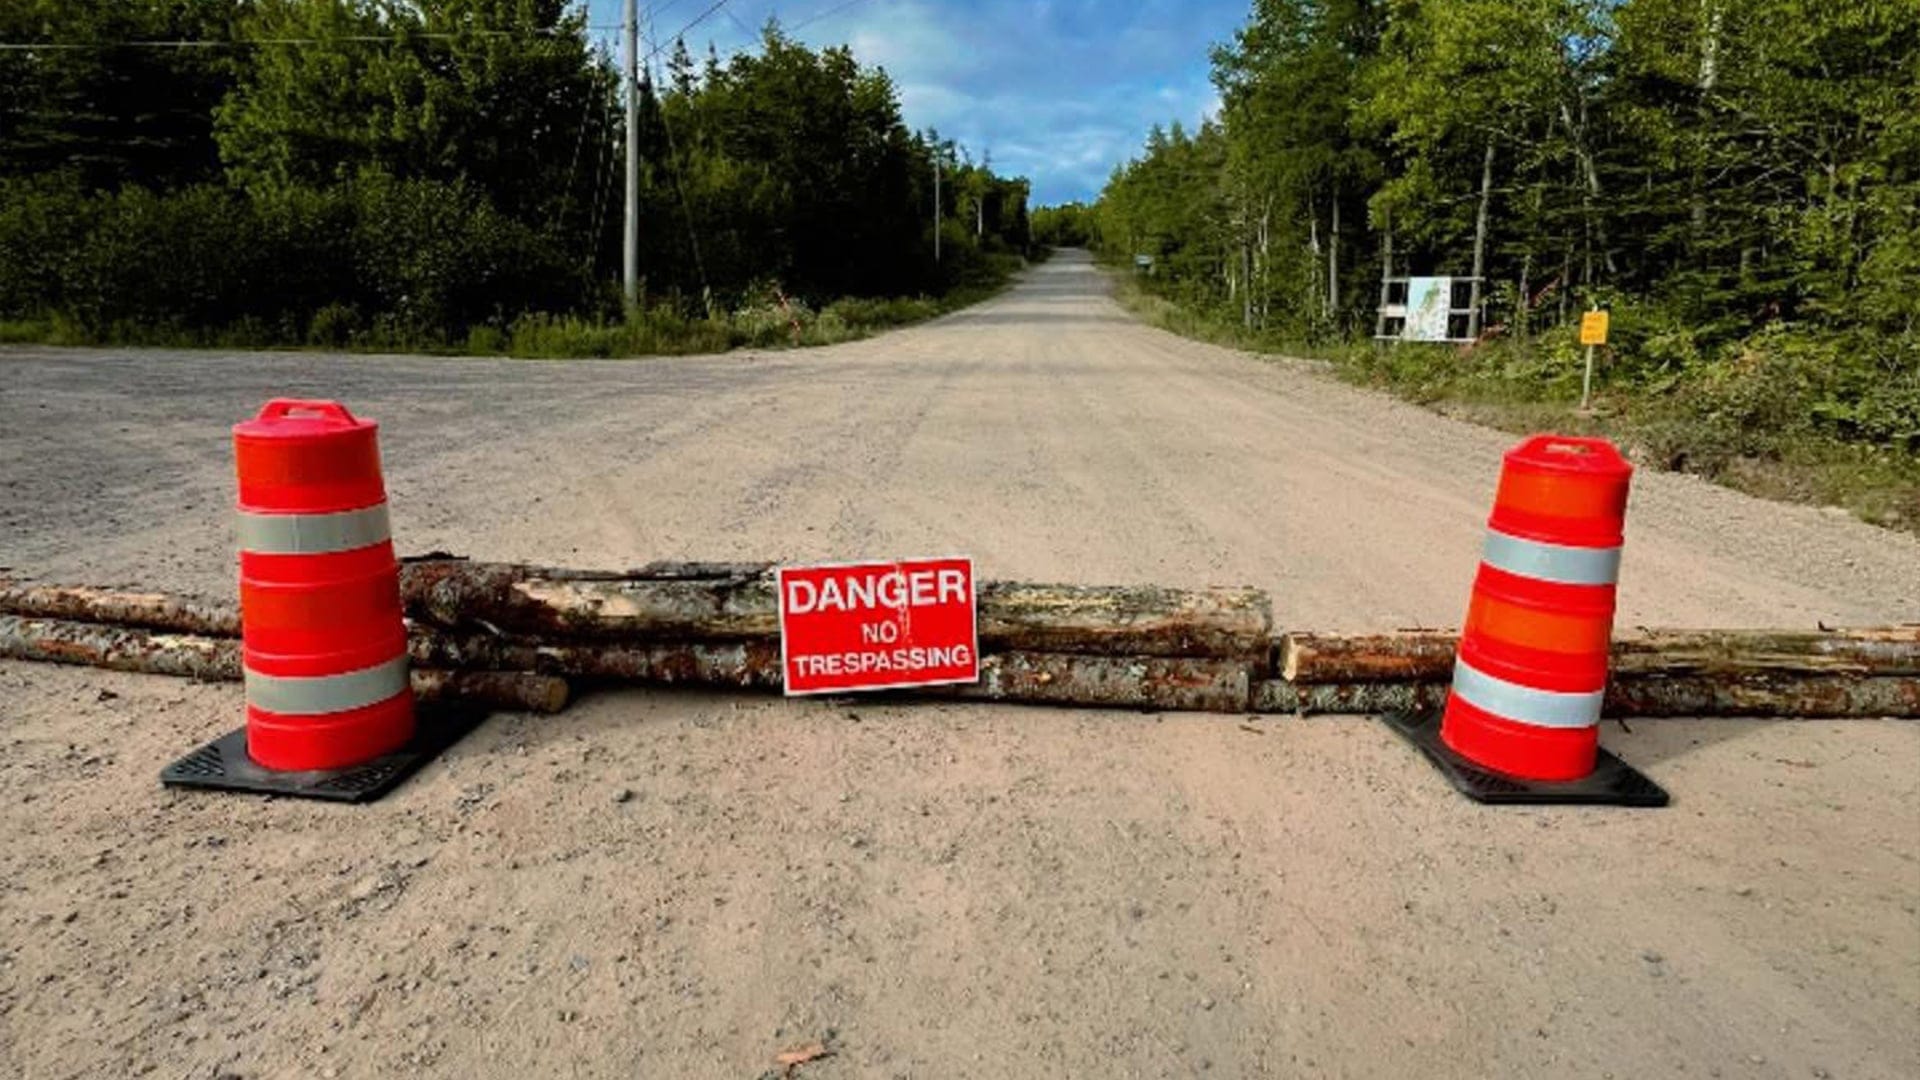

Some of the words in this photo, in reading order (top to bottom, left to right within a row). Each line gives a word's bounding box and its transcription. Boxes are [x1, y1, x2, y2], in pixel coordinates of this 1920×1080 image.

[787, 569, 967, 615] DANGER
[861, 620, 898, 645] NO
[792, 644, 972, 678] TRESPASSING
